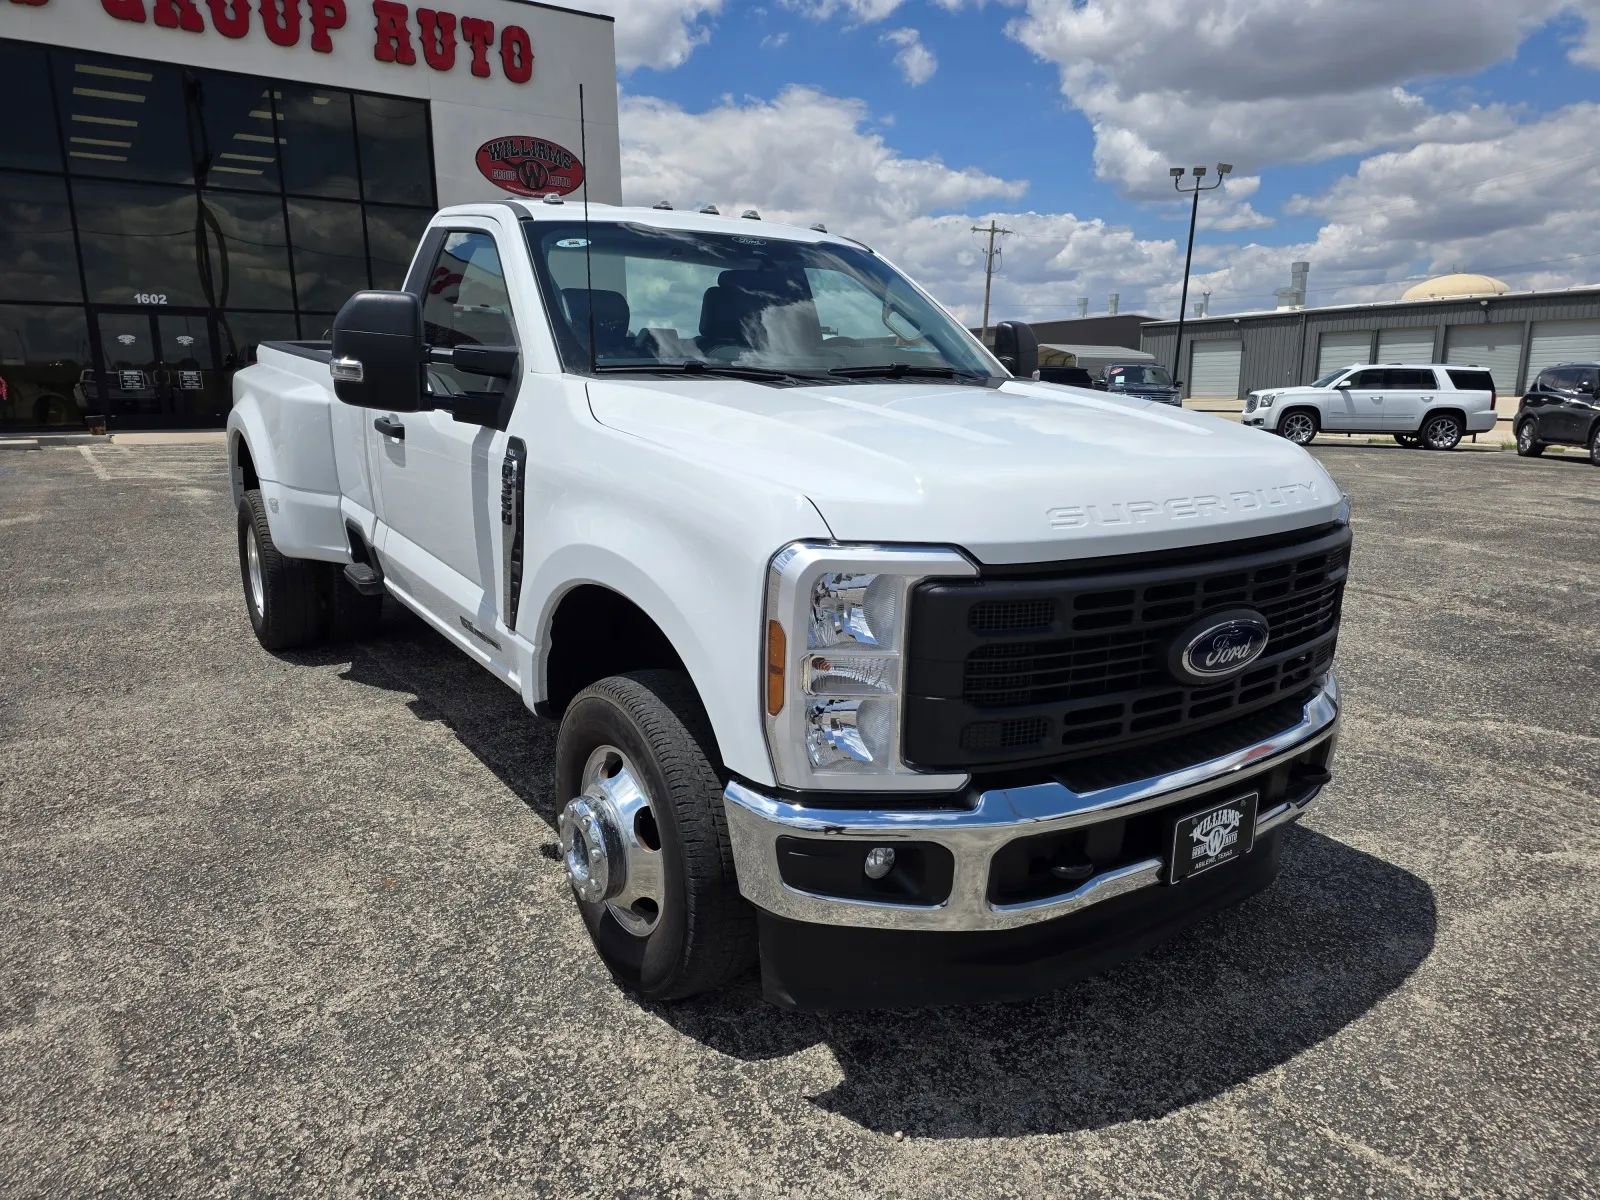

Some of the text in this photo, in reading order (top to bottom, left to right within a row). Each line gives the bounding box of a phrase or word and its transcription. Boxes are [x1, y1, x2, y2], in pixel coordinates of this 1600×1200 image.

[373, 0, 534, 83] AUTO
[488, 139, 572, 169] WILLIAMS
[134, 294, 167, 304] 1602
[1046, 481, 1320, 529] SUPER DUTY
[1205, 631, 1253, 667] Ford
[1193, 809, 1240, 842] WILLIAMS
